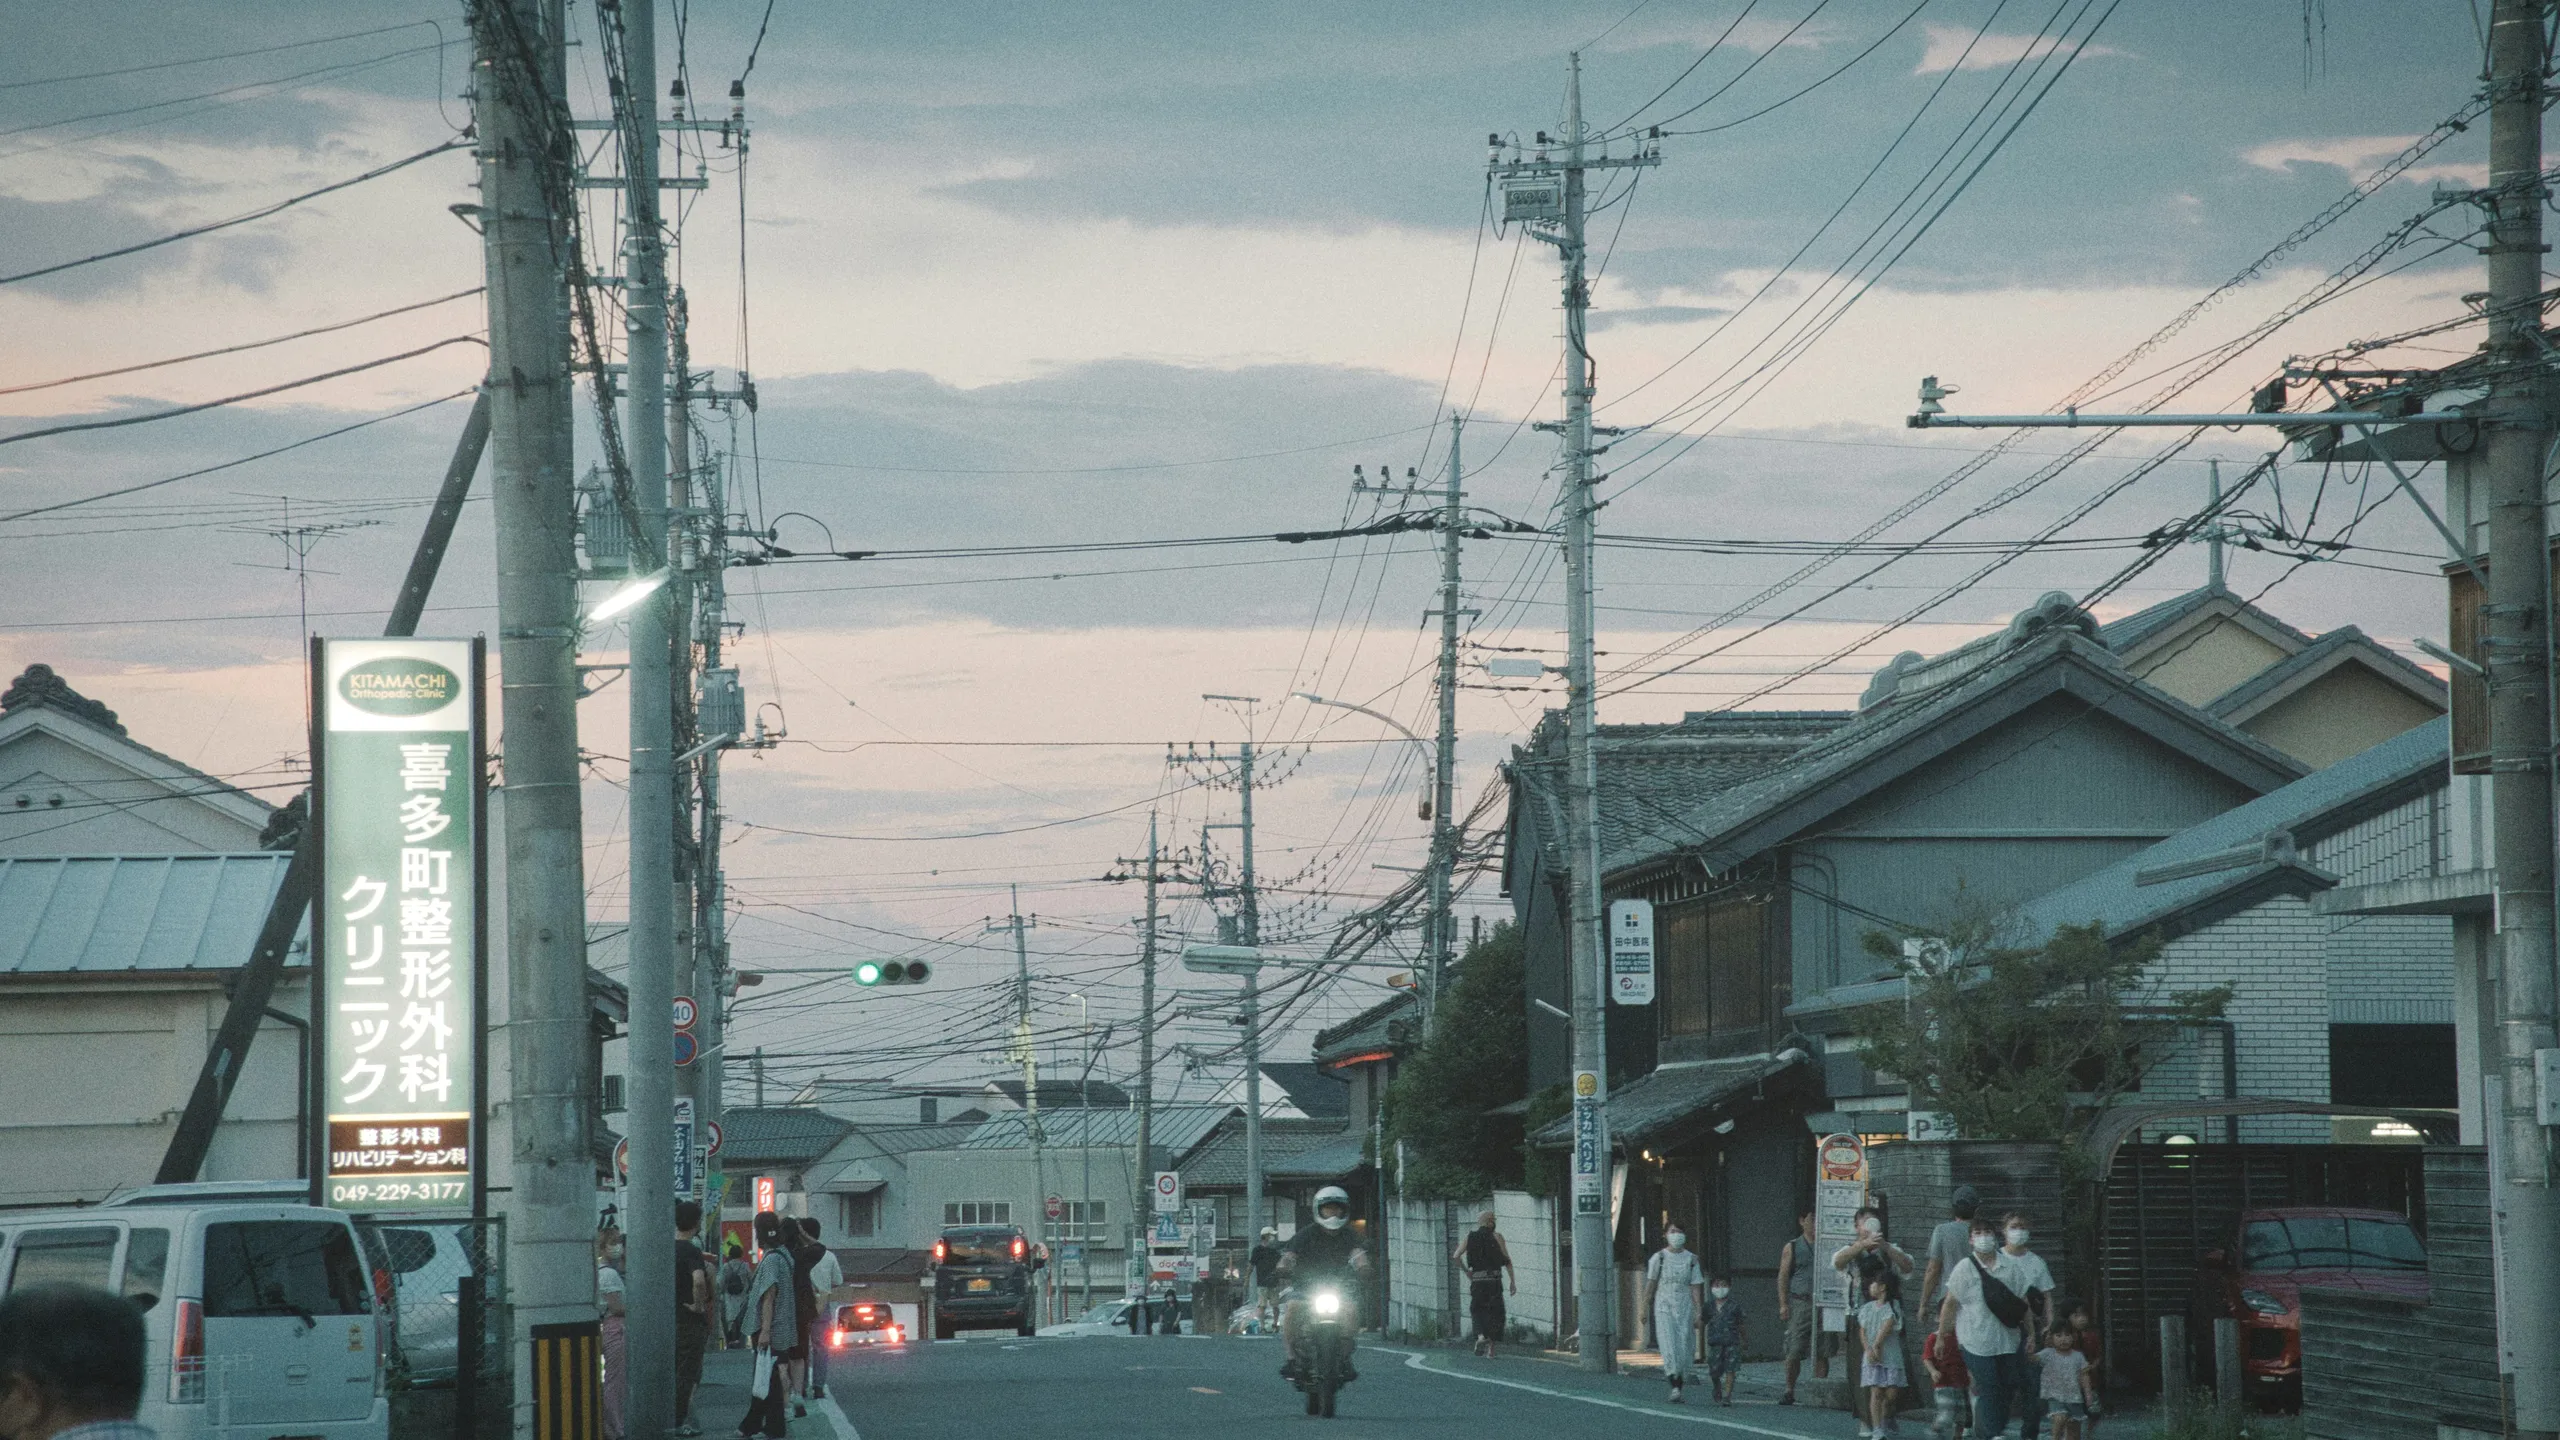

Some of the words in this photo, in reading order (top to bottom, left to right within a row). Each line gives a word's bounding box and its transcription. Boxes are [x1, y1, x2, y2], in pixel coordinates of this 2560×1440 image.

[350, 674, 446, 688] KITAMACHI
[350, 689, 412, 699] Orthopedic
[415, 689, 446, 698] Clinic
[398, 742, 452, 1102] 喜多町整形外科
[1614, 937, 1650, 947] 田中医院
[340, 875, 389, 1104] クリニック
[673, 1005, 691, 1021] 40
[358, 1127, 441, 1146] 整形外科
[1915, 1119, 1931, 1139] P
[332, 1148, 467, 1168] リハビリテーション科
[333, 1182, 466, 1202] 049-229-3177
[760, 1181, 772, 1212] クリ
